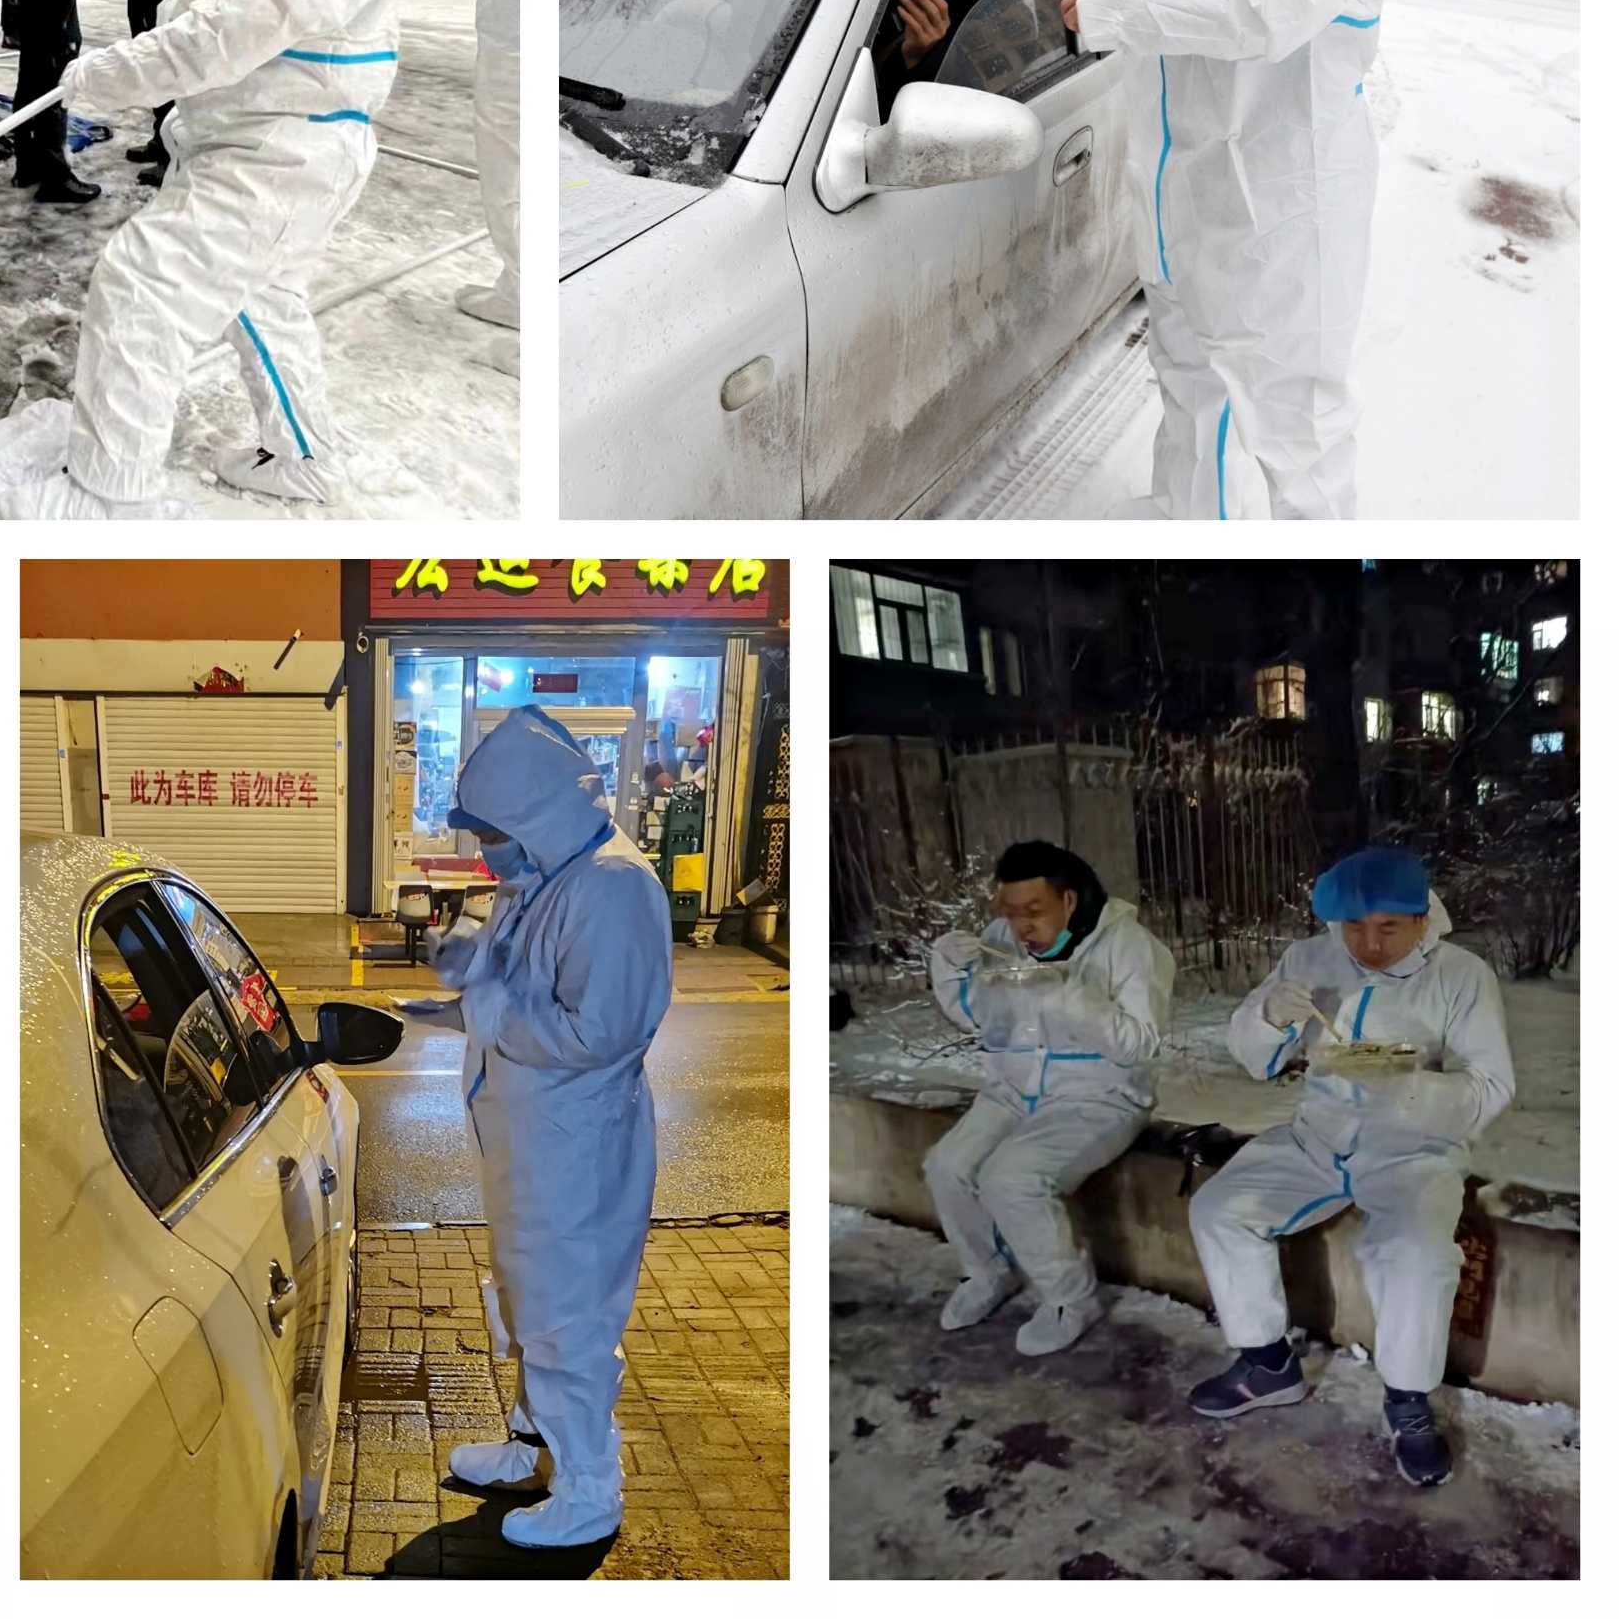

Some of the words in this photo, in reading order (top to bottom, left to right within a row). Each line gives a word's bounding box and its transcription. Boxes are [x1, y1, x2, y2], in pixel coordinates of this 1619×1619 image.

[130, 769, 219, 807] 此为车库
[230, 769, 319, 809] 请勿停车
